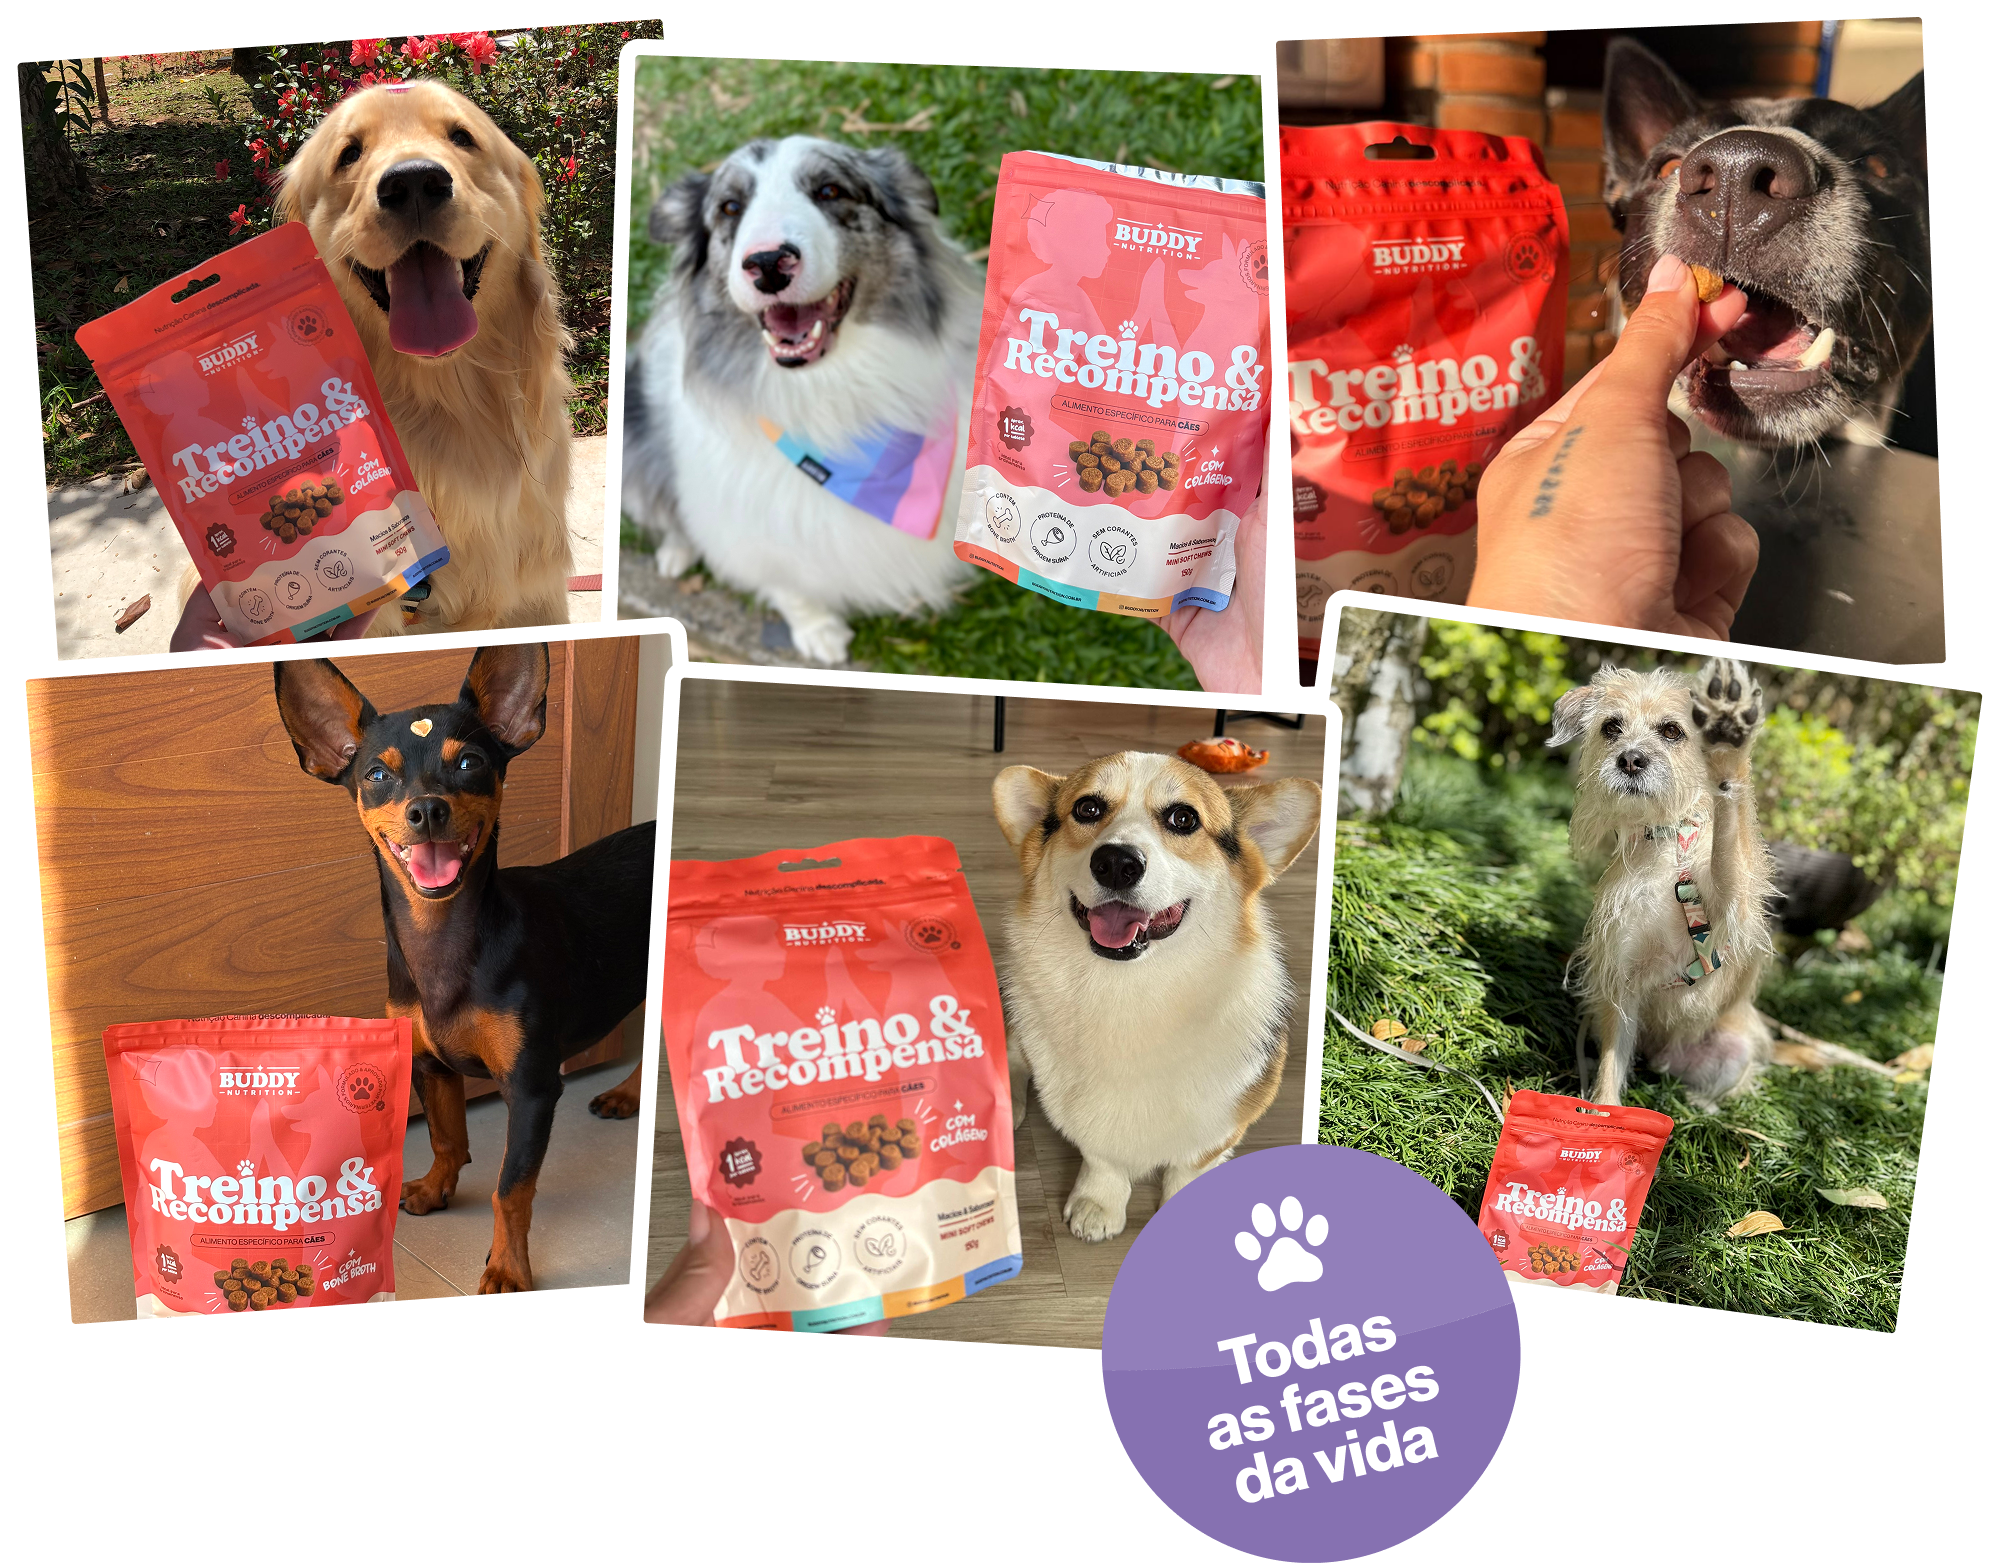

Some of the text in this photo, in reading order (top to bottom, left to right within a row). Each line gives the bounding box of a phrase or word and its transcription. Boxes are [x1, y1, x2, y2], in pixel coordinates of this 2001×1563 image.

[1114, 223, 1202, 252] BUDDY
[1121, 243, 1193, 259] NUTRITION
[1372, 242, 1465, 267] BUDDY
[1382, 262, 1460, 275] NUTRITION
[199, 335, 258, 372] BUDDY
[1019, 307, 1264, 390] Treino &
[210, 350, 259, 375] NUTRITION
[1003, 337, 1262, 412] Recompensa
[1288, 336, 1542, 411] Treino &
[1290, 369, 1546, 435] Recompensa
[1003, 417, 1009, 433] 1
[1061, 399, 1201, 432] ALIMENTO ESPECÍFICO PARA CÃES
[172, 377, 359, 481] Treino &
[1010, 423, 1025, 432] kcal
[177, 399, 370, 504] Recompensa
[1355, 443, 1400, 457] ALIMENTO
[1401, 433, 1451, 449] ESPECÍFICO
[1452, 431, 1475, 442] PARA
[237, 447, 334, 500] ALIMENTO ESPECÍFICO PARA CÃES
[357, 458, 379, 476] COM
[1200, 460, 1225, 472] COM
[350, 466, 392, 494] COLÁGENO
[1184, 473, 1233, 490] COLÁGENO
[1037, 511, 1075, 529] PROTEÍNA DE
[369, 529, 389, 542] Macios
[987, 523, 1000, 540] BONE
[1092, 525, 1139, 547] SEM CORANTES
[319, 549, 347, 560] CORANTES
[375, 545, 389, 555] MINI
[388, 536, 400, 548] SOFT
[1031, 545, 1070, 564] ORIGEM SUÍNA
[1169, 541, 1187, 550] Macios
[1166, 558, 1180, 566] MINI
[1179, 554, 1194, 564] SOFT
[1090, 562, 1128, 578] ARTIFICIAIS
[328, 576, 355, 592] ARTIFICIAIS
[783, 925, 867, 941] BUDDY
[794, 936, 864, 946] NUTRITION
[708, 995, 975, 1074] Treino &
[702, 1033, 985, 1104] Recompensa
[219, 1072, 300, 1088] BUDDY
[781, 1100, 827, 1115] ALIMENTO
[945, 1113, 975, 1130] COM
[930, 1129, 988, 1153] COLÁGENO
[725, 1153, 734, 1172] 1
[1560, 1149, 1602, 1160] BUDDY
[150, 1156, 376, 1204] Treino &
[149, 1183, 383, 1231] Recompensa
[1505, 1182, 1627, 1221] Treino &
[1495, 1193, 1627, 1232] Recompensa
[959, 1224, 977, 1236] SOFT
[200, 1234, 325, 1246] ALIMENTO ESPECÍFICO PARA CÃES
[338, 1256, 361, 1274] COM
[323, 1262, 376, 1292] BONE BROTH
